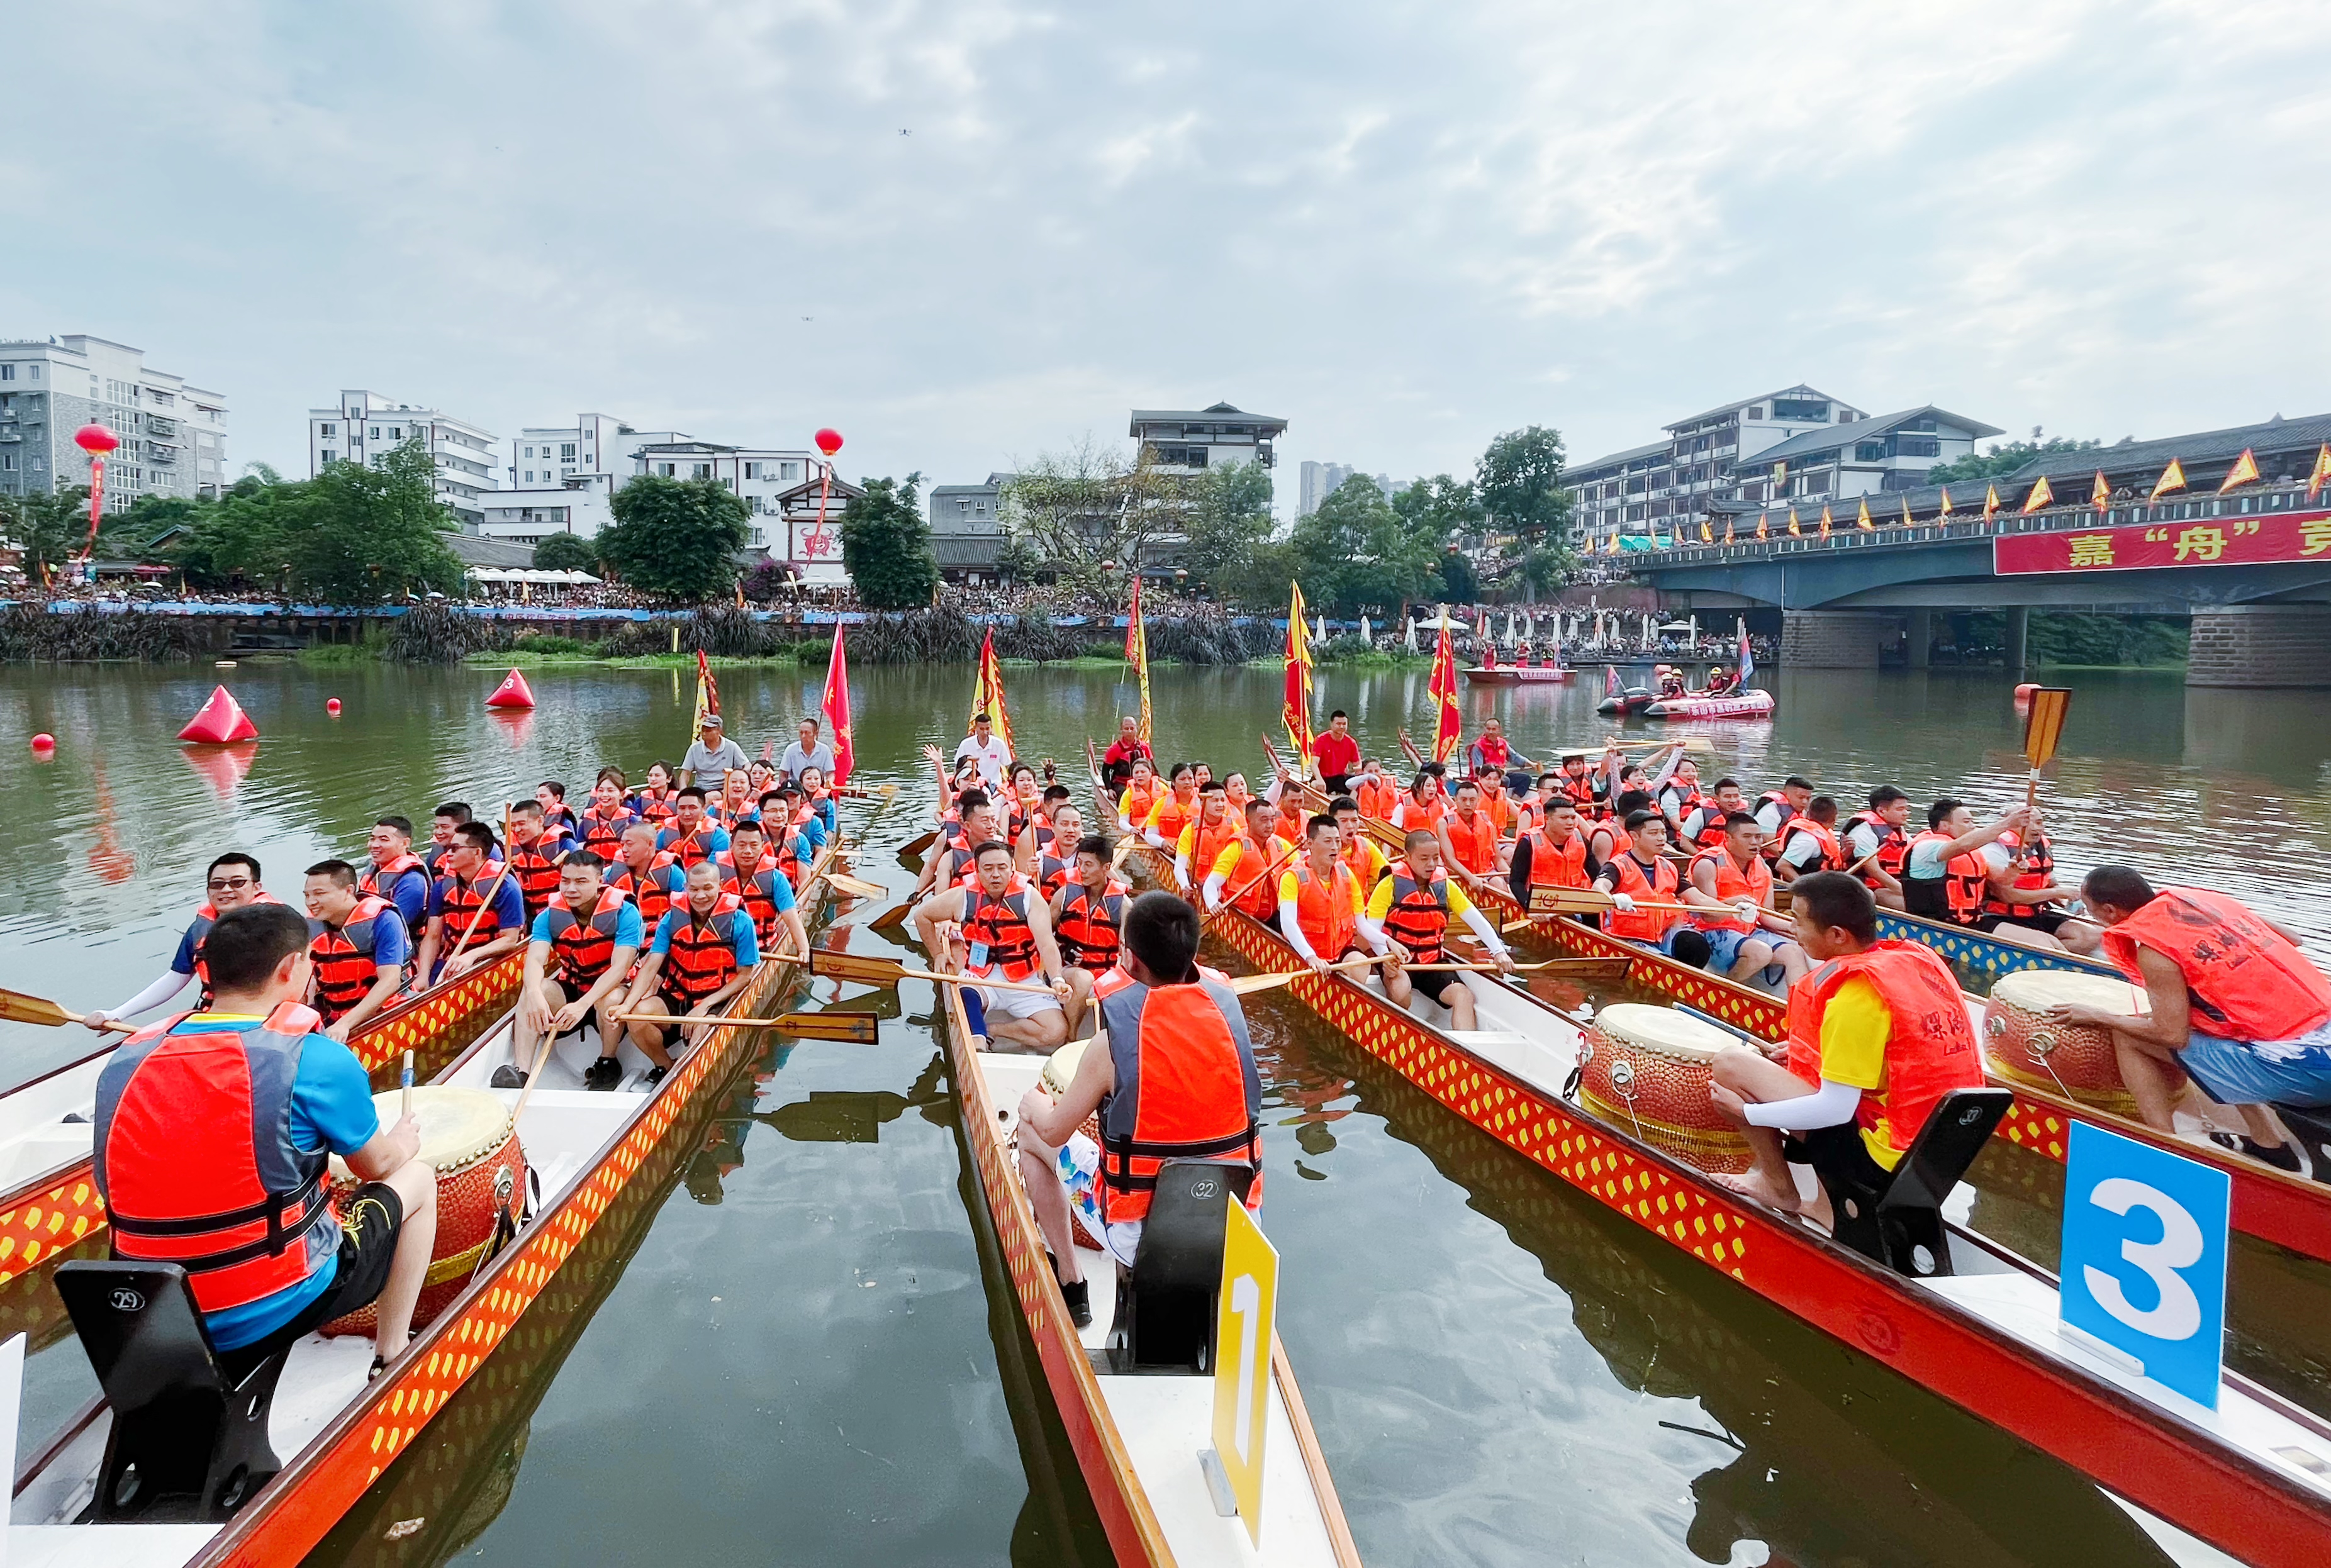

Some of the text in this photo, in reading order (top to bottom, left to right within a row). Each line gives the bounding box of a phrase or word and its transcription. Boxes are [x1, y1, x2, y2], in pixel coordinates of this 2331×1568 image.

[504, 678, 515, 689] 3
[201, 696, 215, 712] 2
[1195, 1182, 1214, 1197] 32
[2083, 1177, 2203, 1340] 3
[114, 1291, 138, 1309] 29
[1231, 1273, 1260, 1467] 1
